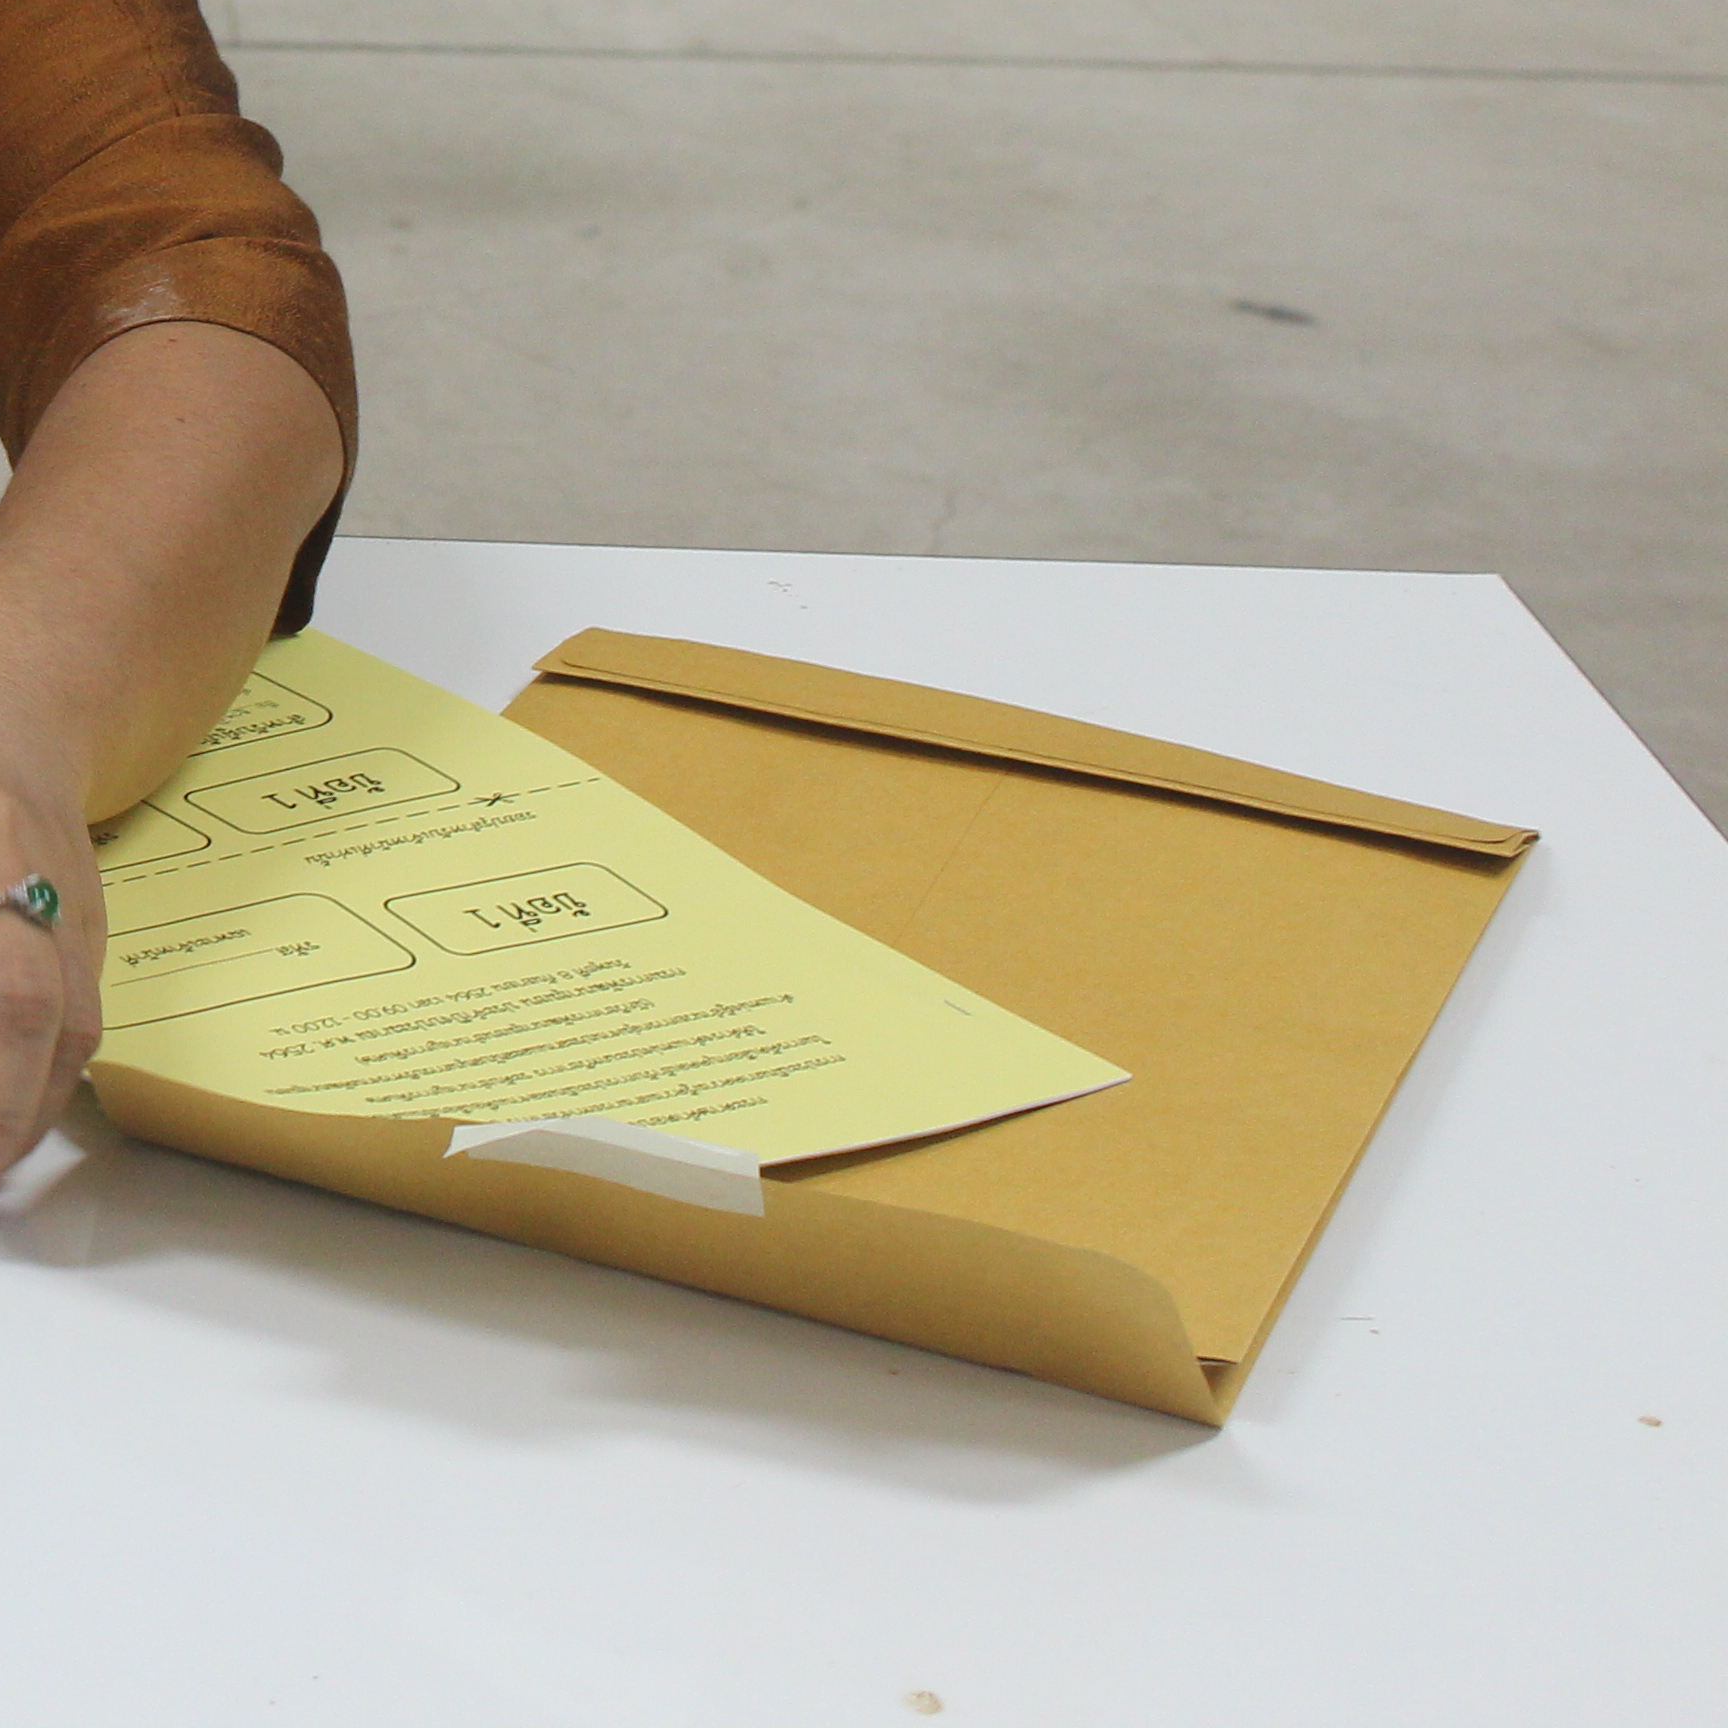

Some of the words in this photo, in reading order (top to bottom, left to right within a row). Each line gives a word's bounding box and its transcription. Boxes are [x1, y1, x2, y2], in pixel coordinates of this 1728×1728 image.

[295, 773, 385, 809] ข้อที่
[261, 794, 297, 809] 1
[464, 909, 501, 928] 1
[497, 893, 590, 932] ข้อที่
[445, 987, 492, 1002] 2564
[353, 1004, 408, 1021] 09.00
[259, 1043, 315, 1060] 2564
